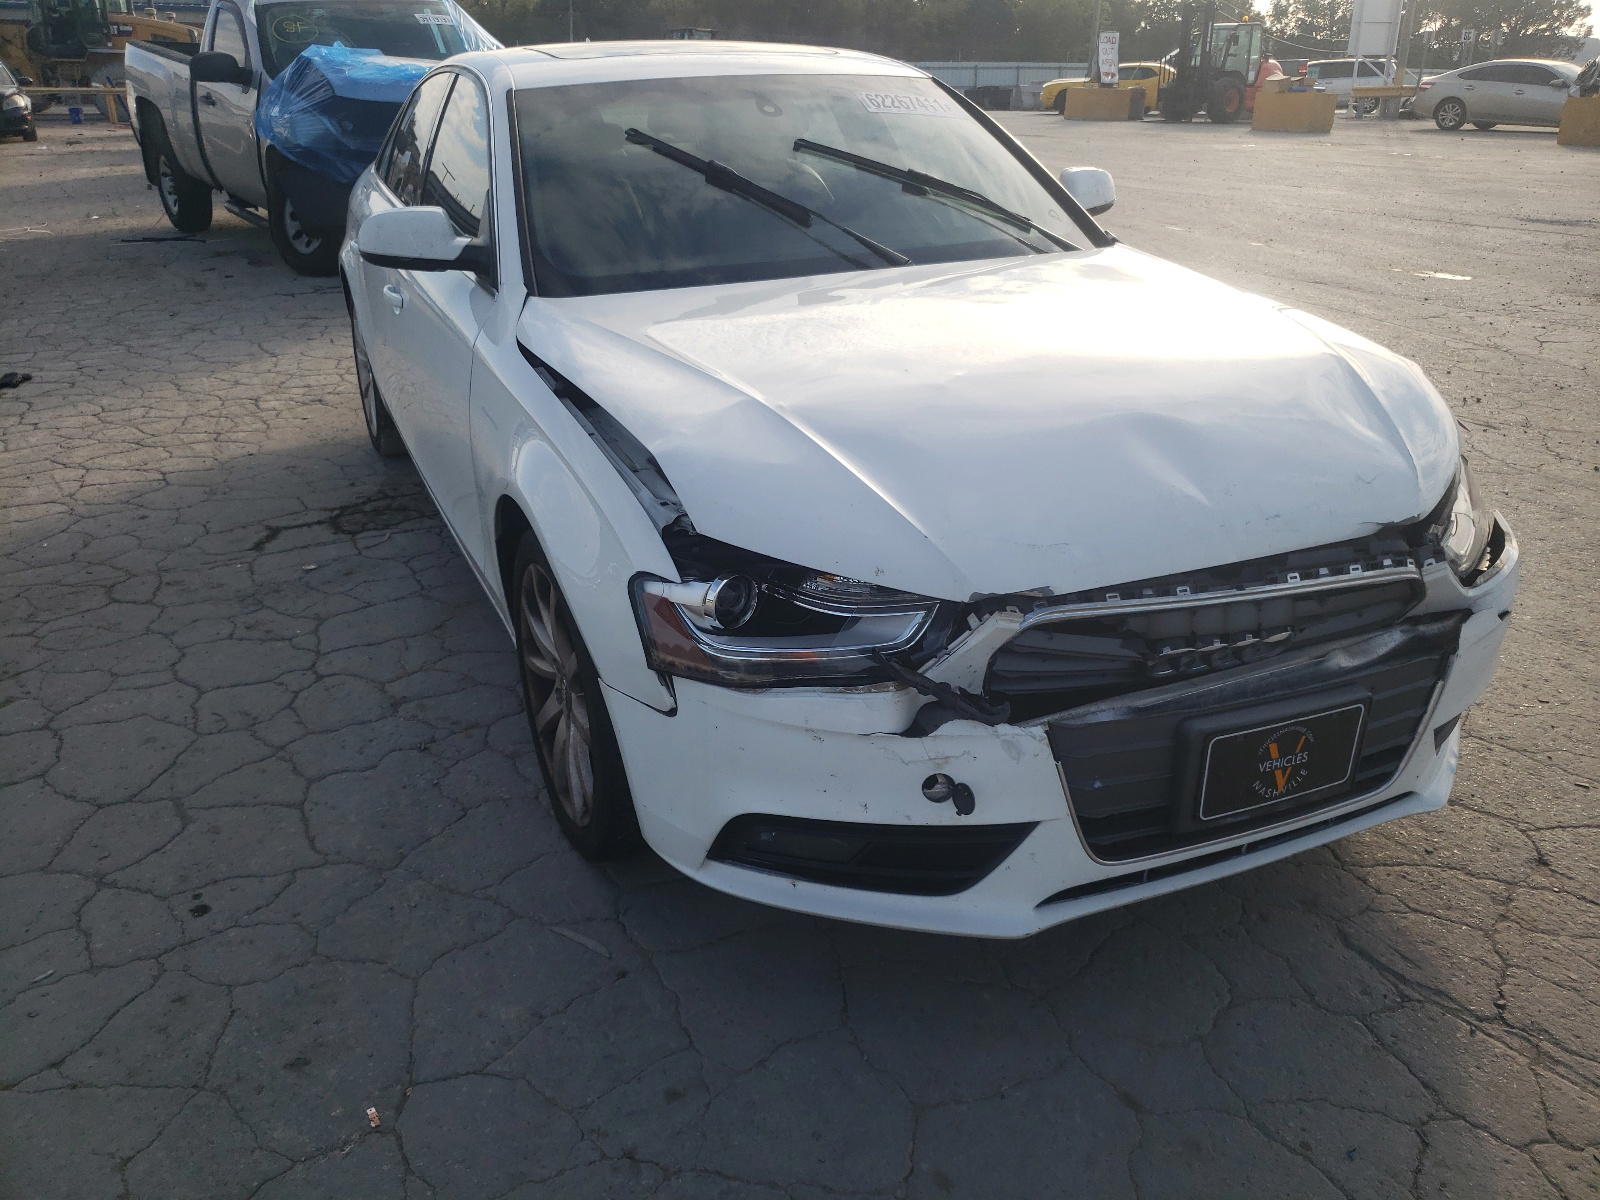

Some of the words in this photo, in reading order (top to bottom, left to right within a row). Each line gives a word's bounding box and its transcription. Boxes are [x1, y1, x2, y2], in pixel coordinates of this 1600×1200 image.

[1099, 36, 1116, 45] LOAD
[1258, 751, 1309, 773] VEHICLES
[1252, 769, 1309, 799] NASHVILLE
